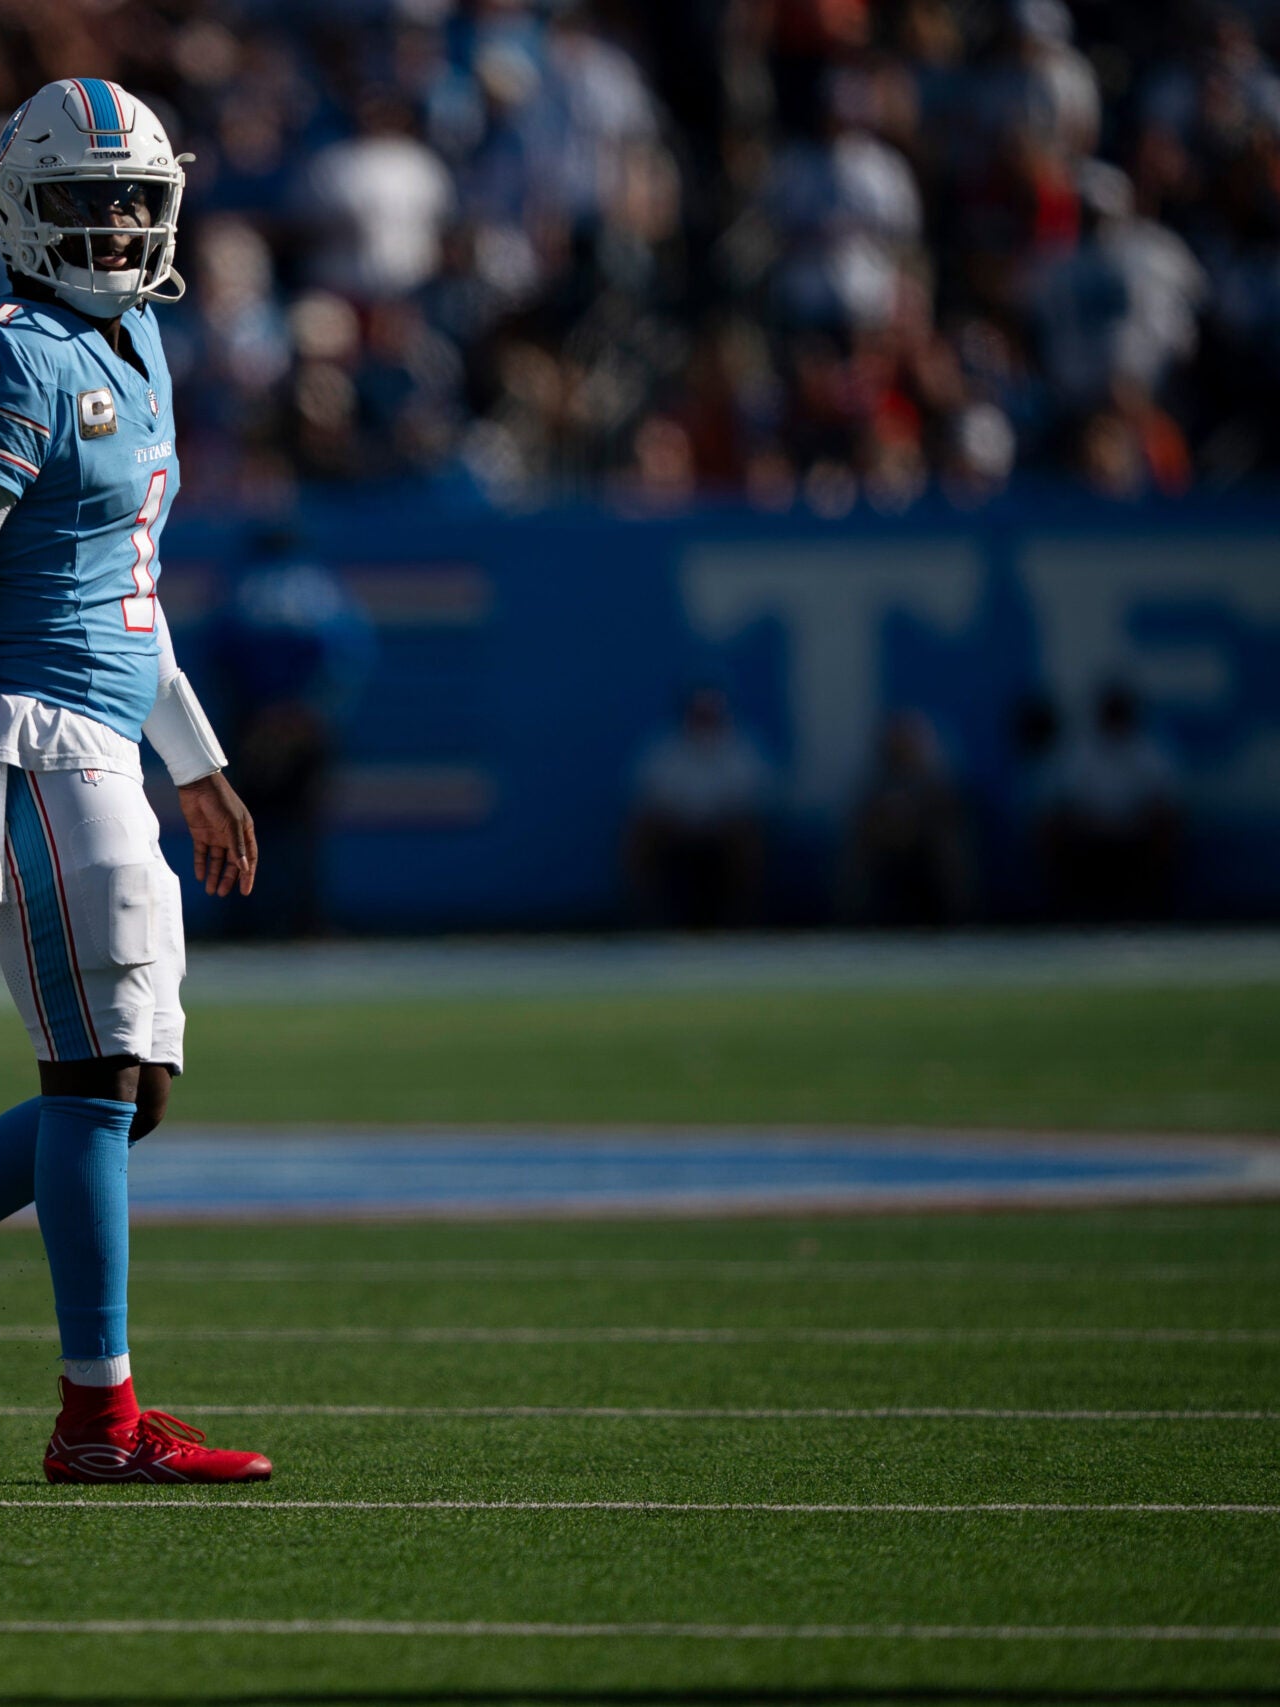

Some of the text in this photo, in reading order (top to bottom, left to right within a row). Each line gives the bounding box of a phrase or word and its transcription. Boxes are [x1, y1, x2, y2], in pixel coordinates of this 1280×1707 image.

[92, 151, 131, 159] TITANS
[81, 390, 114, 426] C
[134, 440, 172, 464] TITANS
[121, 468, 168, 632] 1
